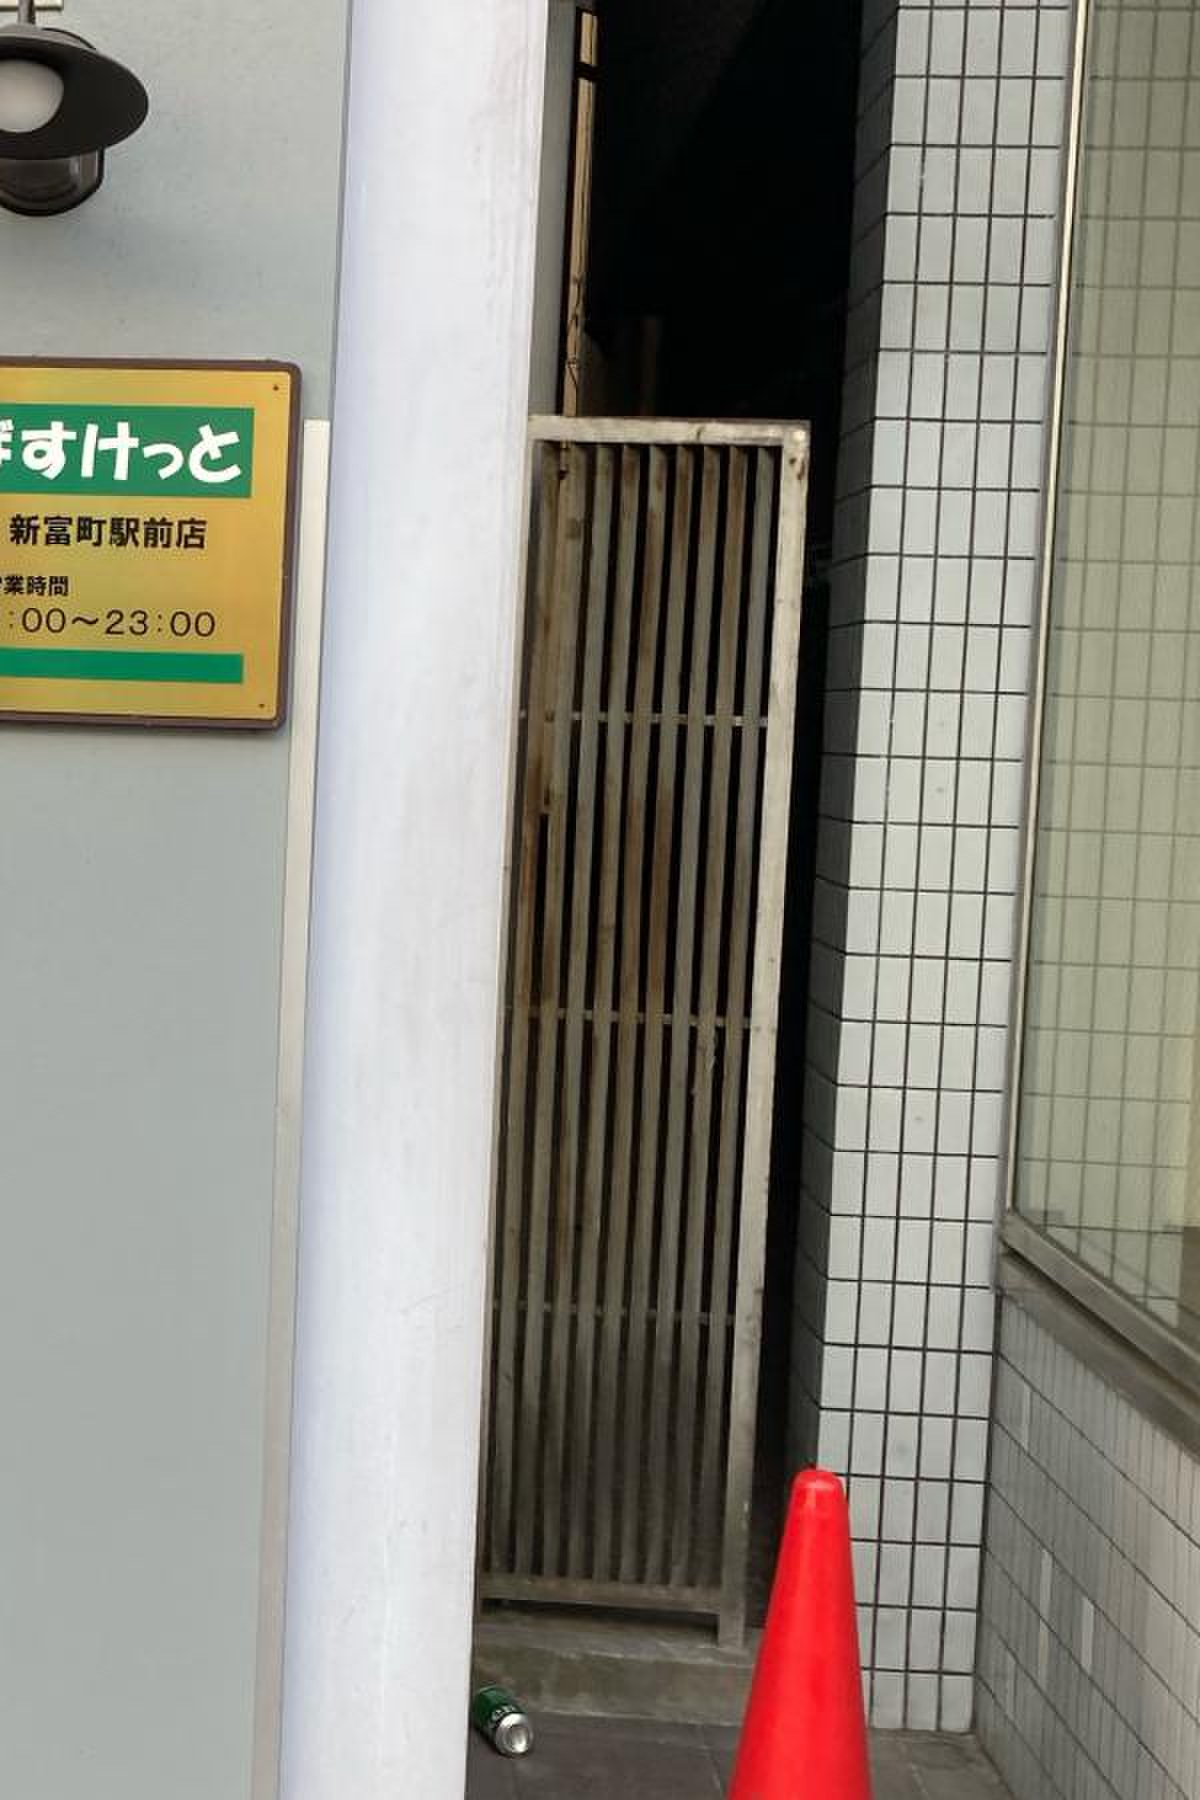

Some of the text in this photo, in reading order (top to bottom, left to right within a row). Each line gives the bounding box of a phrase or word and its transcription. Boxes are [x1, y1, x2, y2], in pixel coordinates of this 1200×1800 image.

[9, 513, 208, 550] 新富町駅前店
